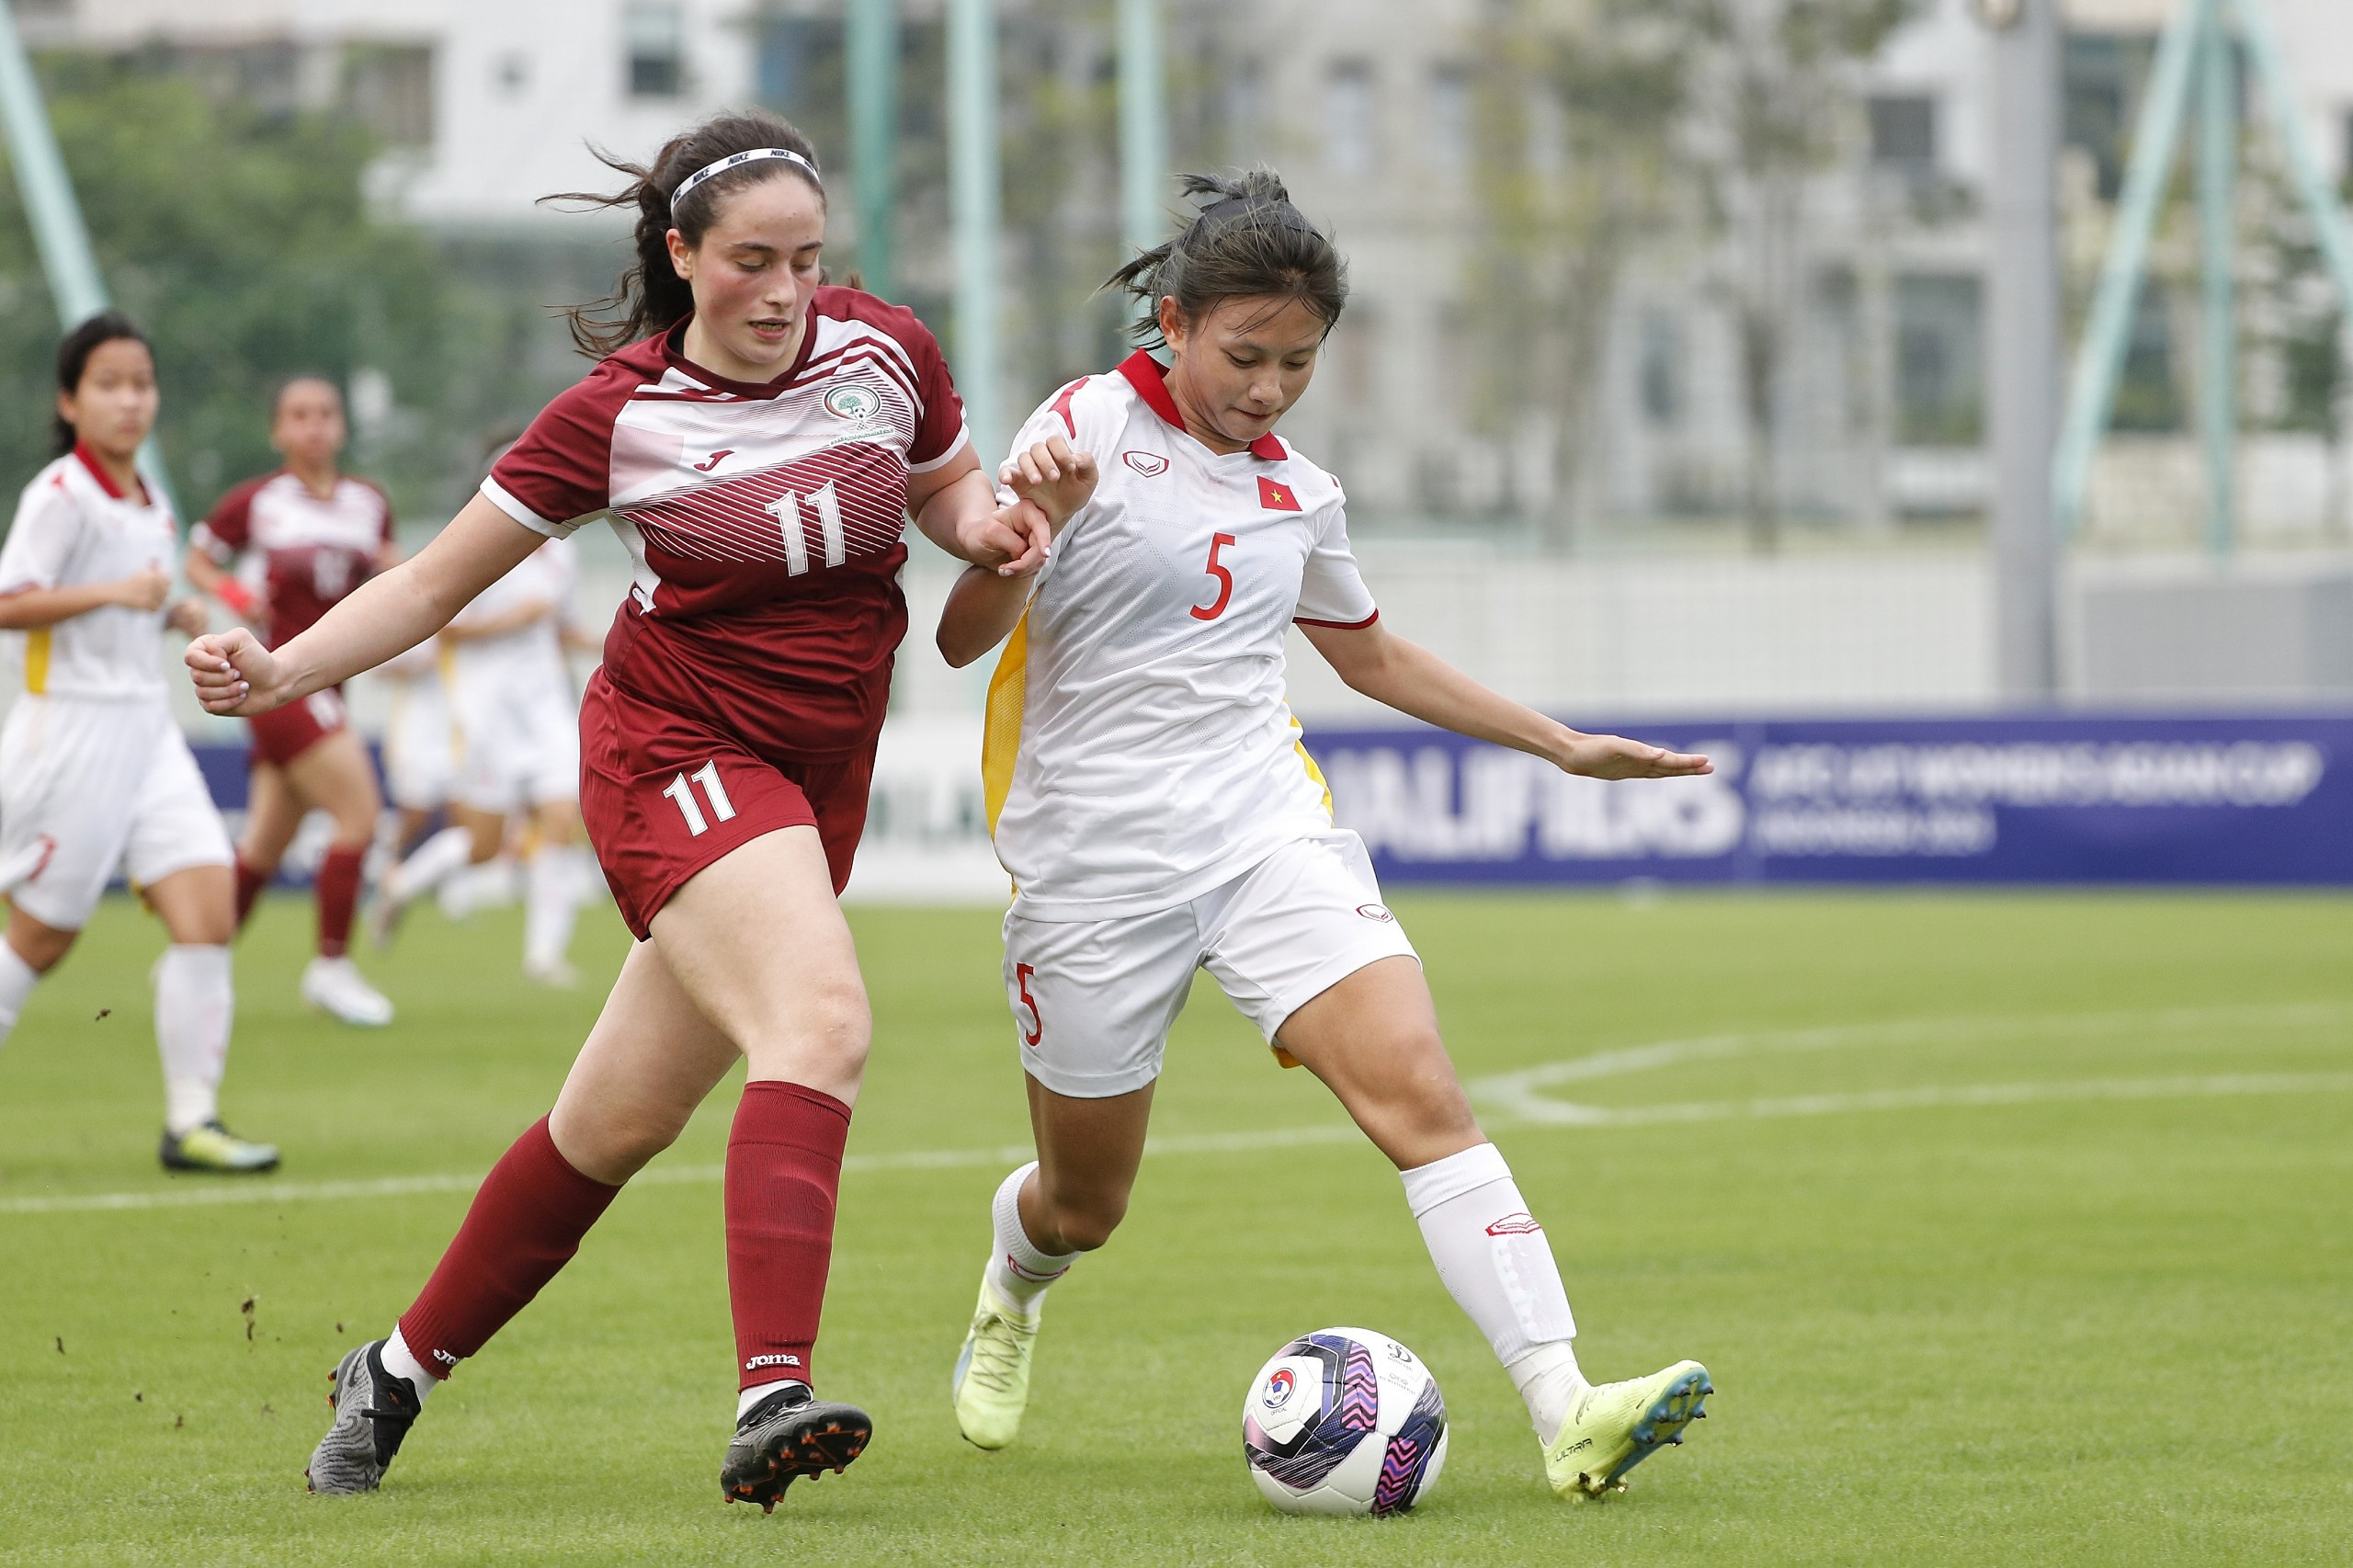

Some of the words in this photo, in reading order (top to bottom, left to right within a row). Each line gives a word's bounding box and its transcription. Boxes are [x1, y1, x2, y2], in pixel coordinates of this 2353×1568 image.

[692, 167, 710, 185] NIKE
[727, 152, 751, 166] NIKE
[770, 149, 791, 158] NIKE
[765, 478, 846, 577] 11
[1188, 531, 1236, 621] 5
[663, 759, 736, 837] 11
[1016, 961, 1042, 1047] 5
